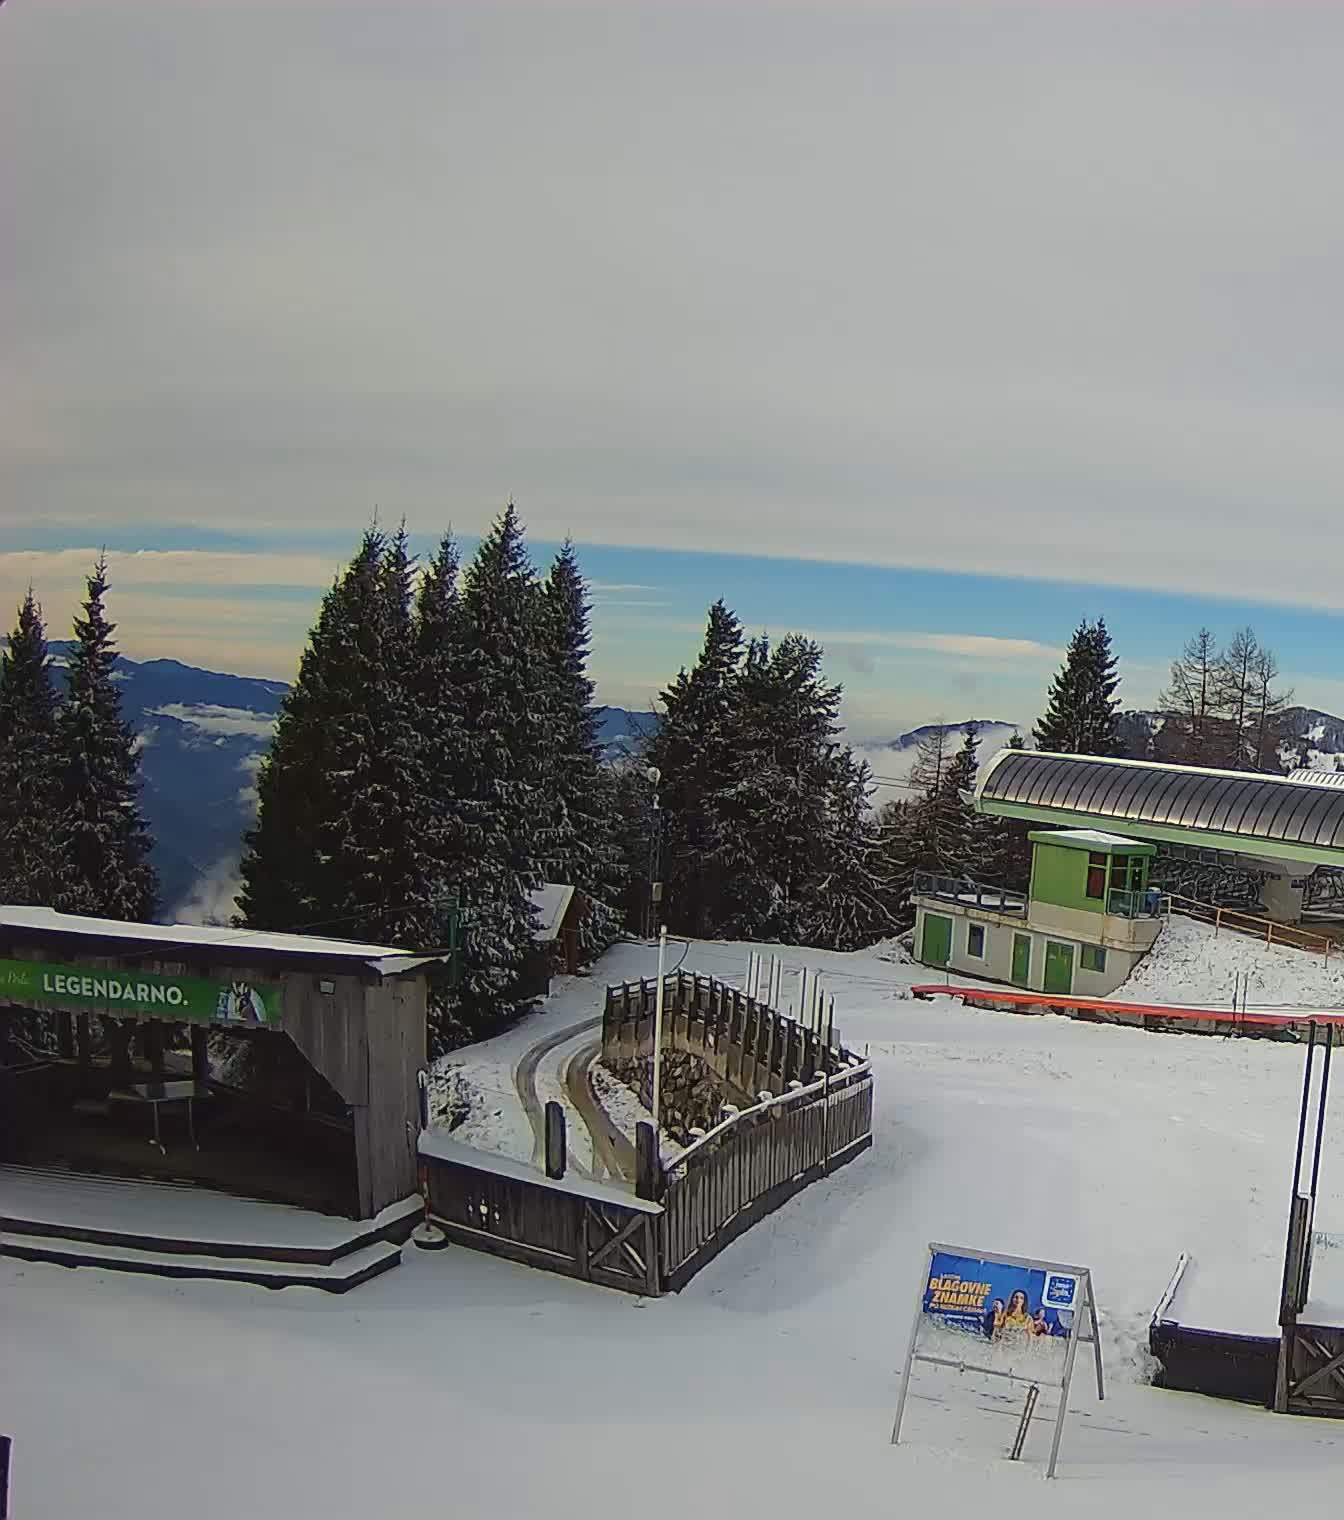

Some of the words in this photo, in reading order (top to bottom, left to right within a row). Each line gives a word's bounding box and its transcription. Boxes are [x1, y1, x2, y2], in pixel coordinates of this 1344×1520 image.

[43, 973, 189, 1006] LEGENDARNO.
[929, 1277, 992, 1296] BLAGOVNE
[931, 1290, 985, 1307] ZNAMKE
